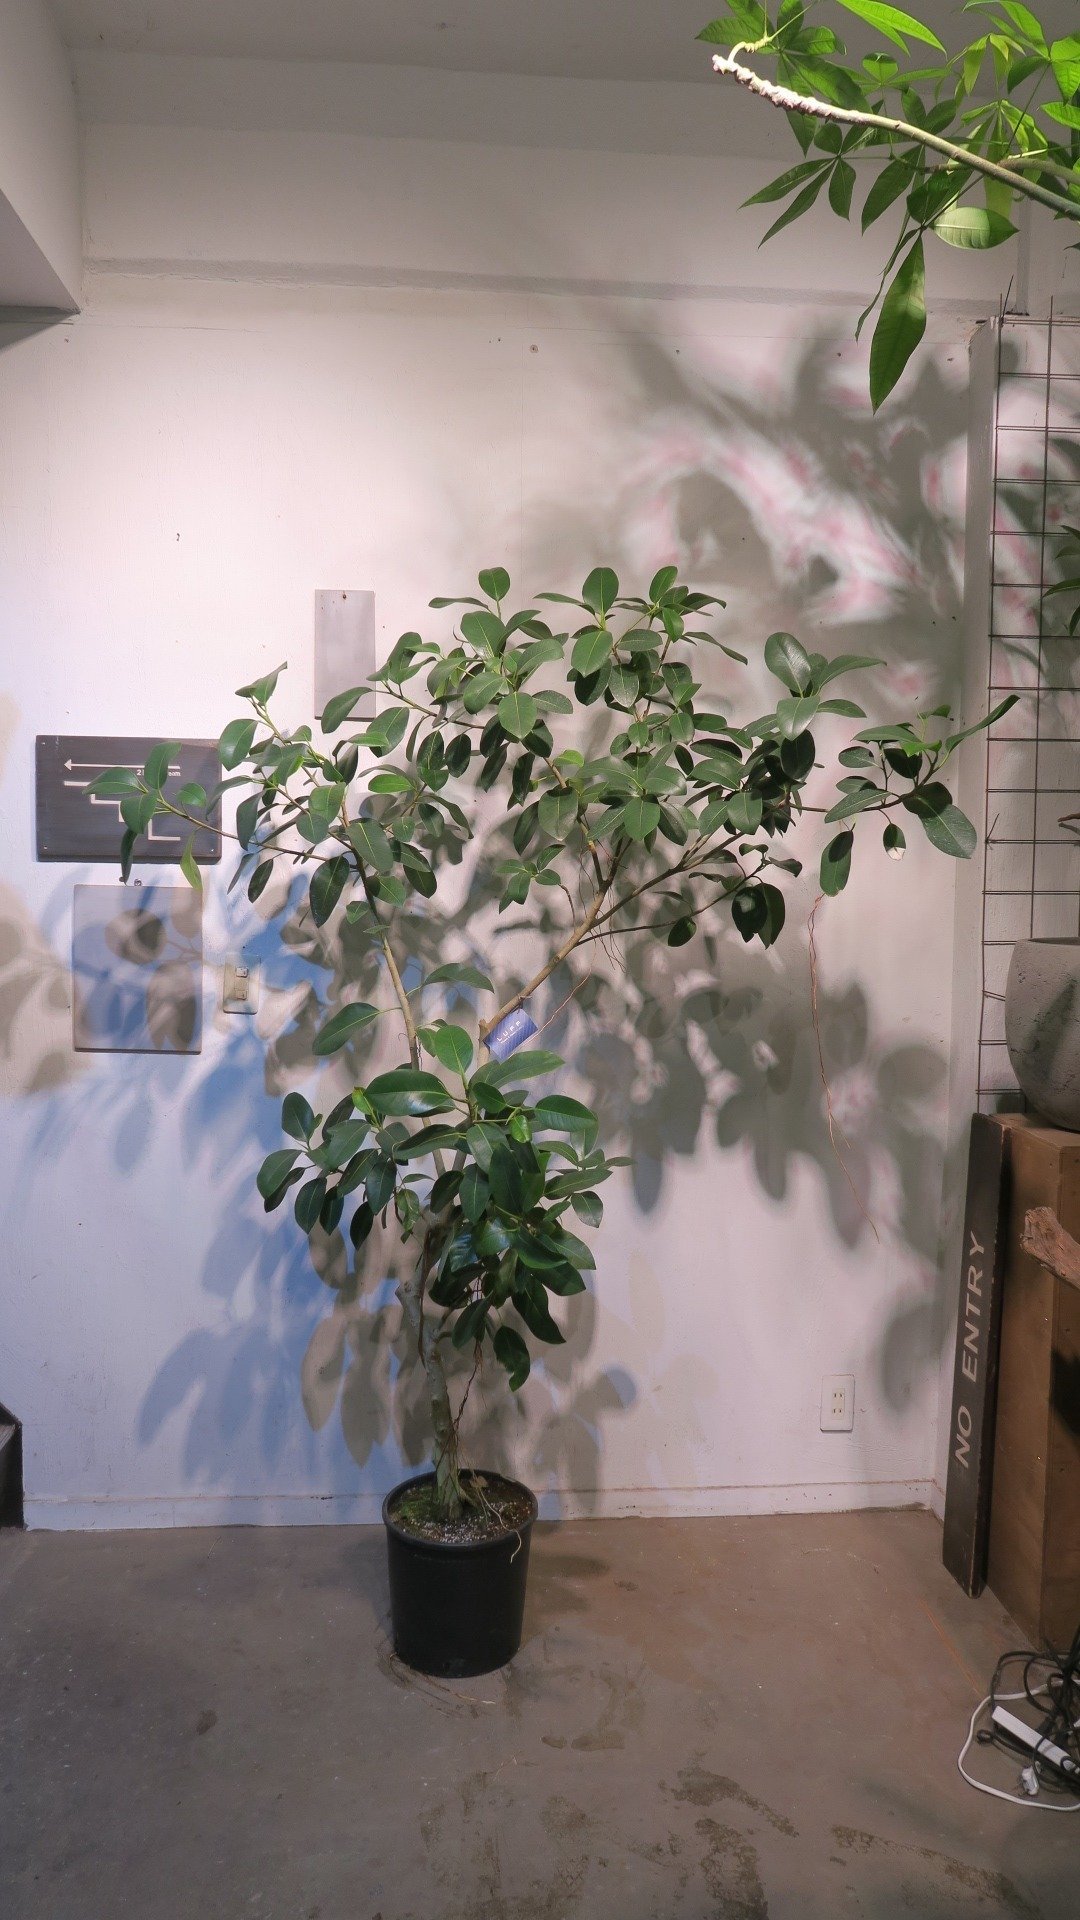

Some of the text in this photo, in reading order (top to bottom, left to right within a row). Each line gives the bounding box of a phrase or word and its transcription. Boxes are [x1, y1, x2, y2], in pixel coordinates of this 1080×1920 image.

[496, 1020, 521, 1042] LUFF
[955, 1230, 985, 1469] NO ENTRY
